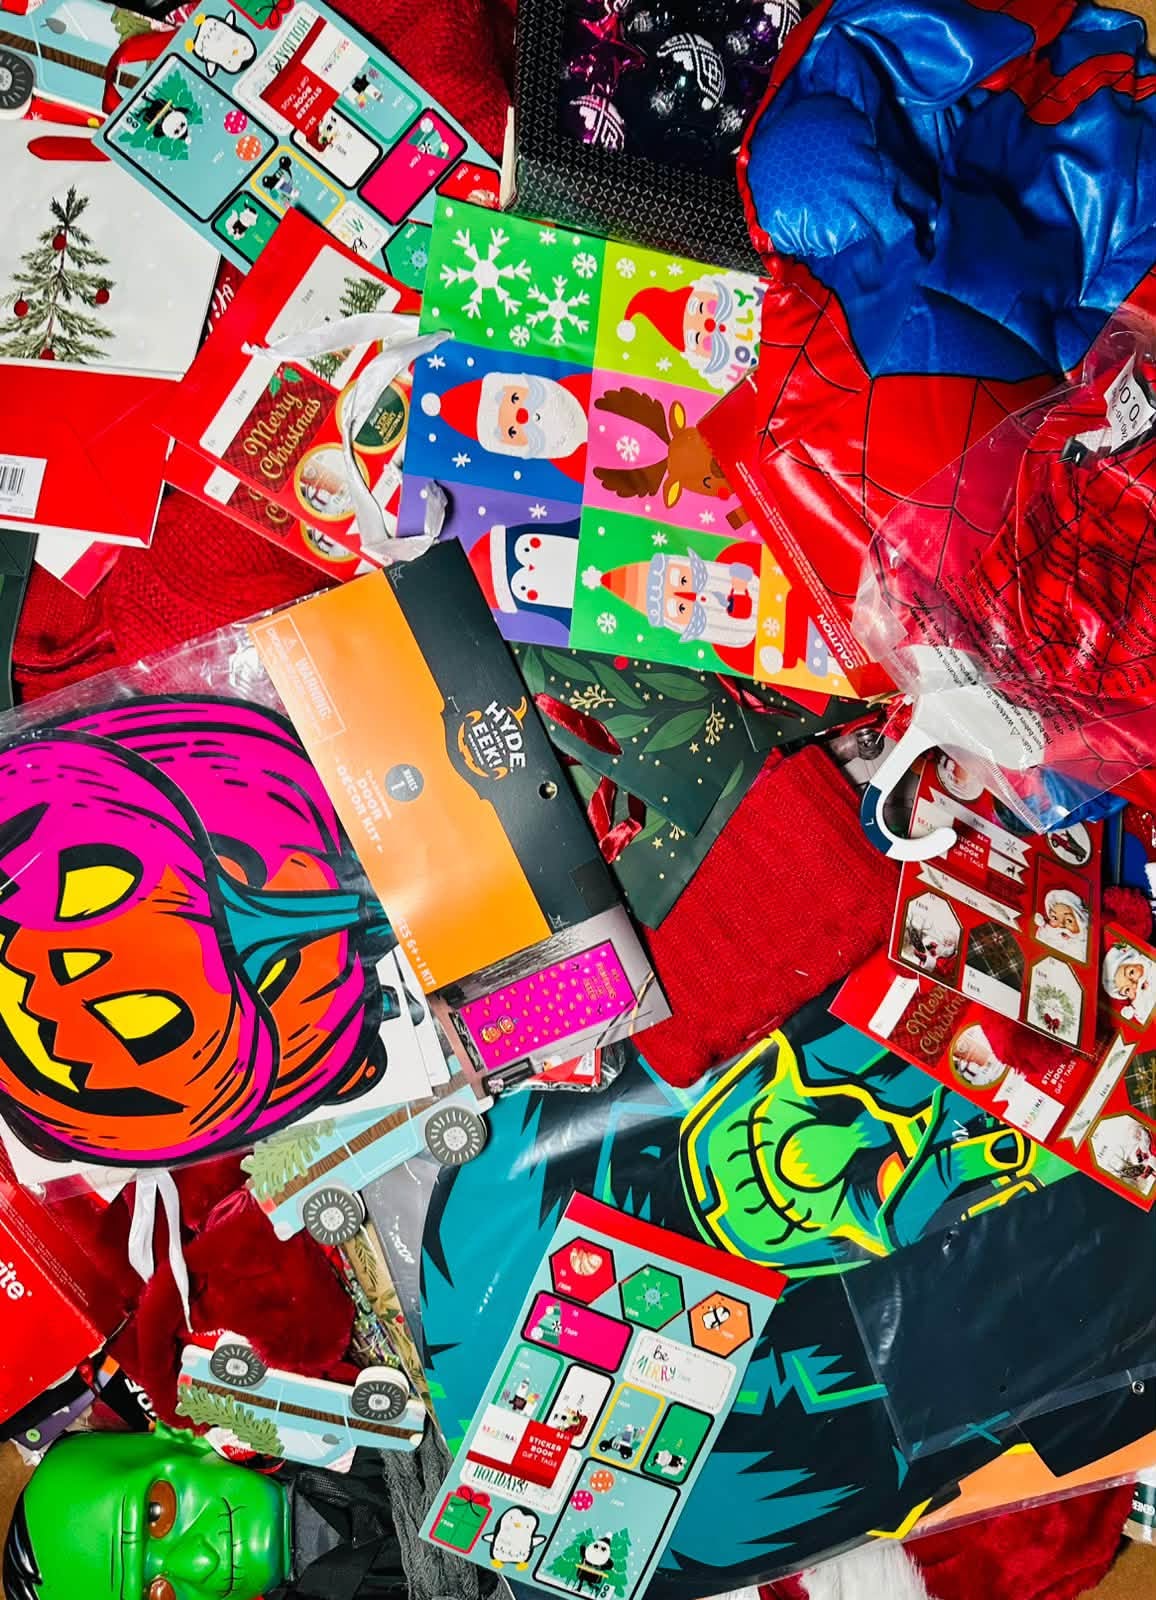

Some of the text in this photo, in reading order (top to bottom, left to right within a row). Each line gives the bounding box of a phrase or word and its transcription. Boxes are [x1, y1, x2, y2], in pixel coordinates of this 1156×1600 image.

[293, 85, 313, 109] BOOK
[296, 87, 323, 120] STICKER
[726, 288, 754, 383] HOLLY
[243, 391, 306, 456] Merry
[260, 397, 321, 480] Christmas
[817, 613, 854, 669] CAUTION
[472, 721, 503, 768] EEK!
[485, 701, 526, 768] HYDE
[356, 778, 384, 821] DOOR
[391, 780, 405, 792] 1
[336, 764, 367, 815] DECOR
[362, 815, 382, 844] KIT
[959, 844, 979, 859] BOOK
[421, 967, 438, 988] KIT
[906, 986, 948, 1034] Merr
[1051, 1064, 1067, 1085] BOOK
[637, 1355, 676, 1384] MERRY
[653, 1345, 669, 1362] be
[528, 1435, 562, 1453] STICKER
[530, 1445, 554, 1458] BOOK
[472, 1464, 529, 1495] HOLIDAYS!
